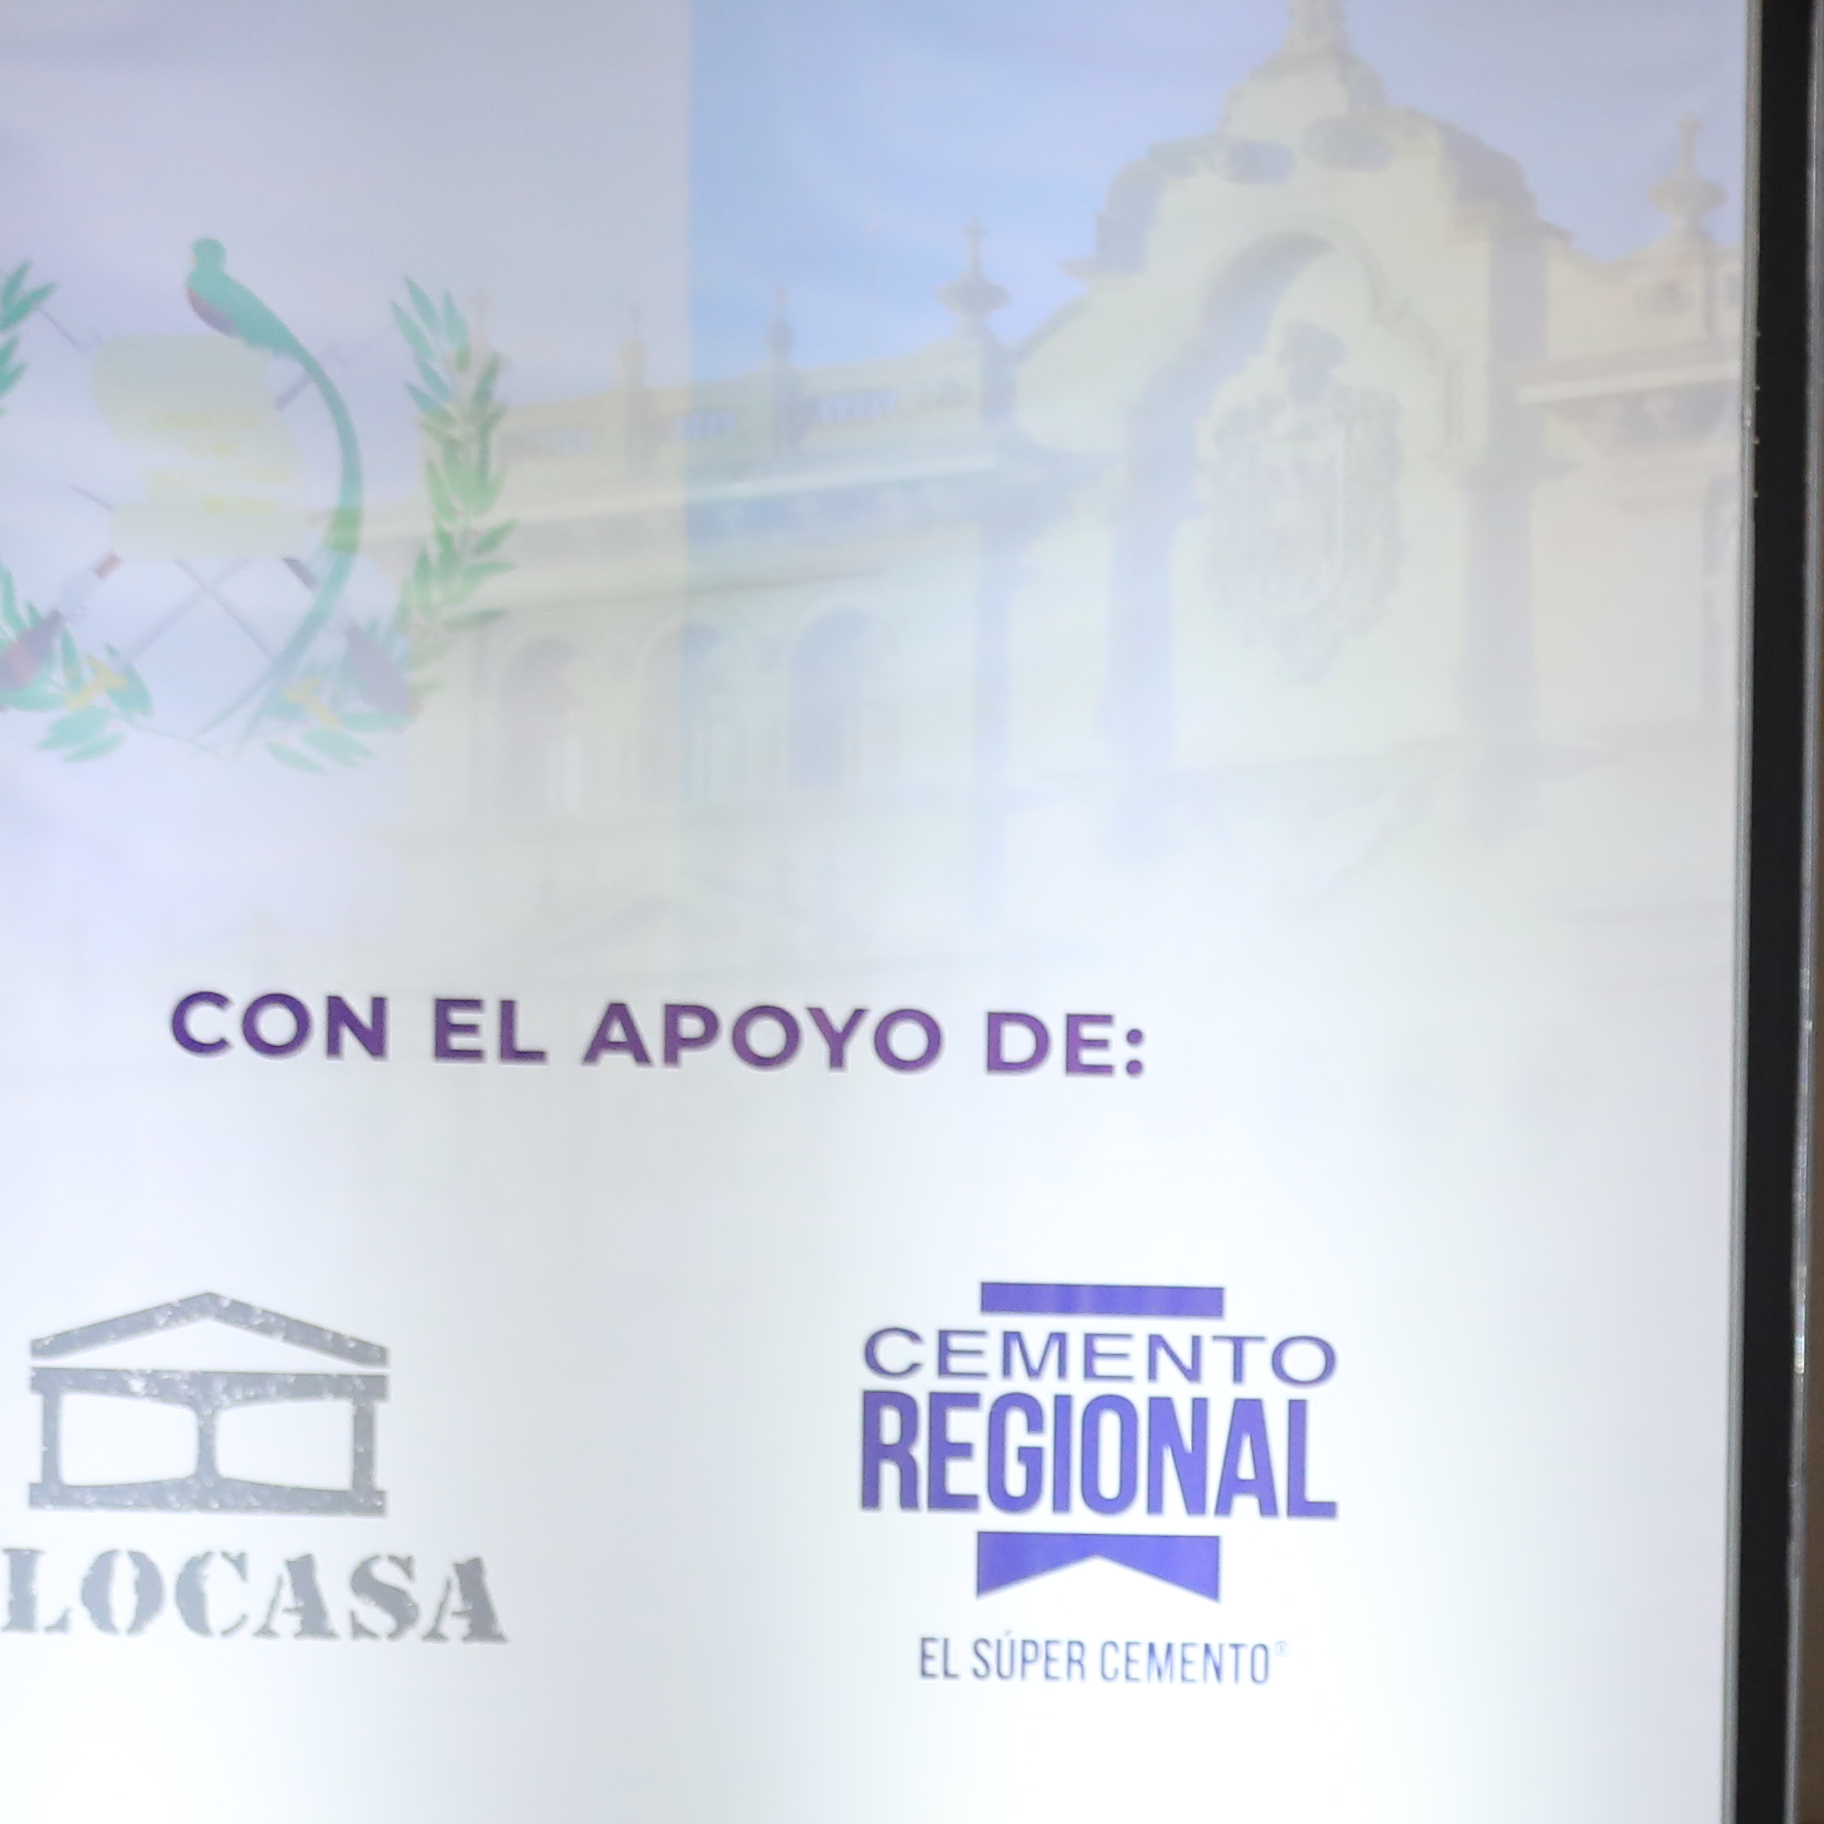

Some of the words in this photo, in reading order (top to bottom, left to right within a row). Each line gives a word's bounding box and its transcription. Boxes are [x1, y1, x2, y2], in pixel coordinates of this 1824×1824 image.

[170, 989, 389, 1060] CON
[432, 996, 547, 1066] EL
[581, 1000, 943, 1073] APOYO
[984, 1010, 1147, 1077] DE:
[860, 1324, 1338, 1388] CEMENTO
[859, 1389, 1339, 1521] REGIONAL
[919, 1635, 960, 1681] EL
[972, 1629, 1088, 1682] SÚPER
